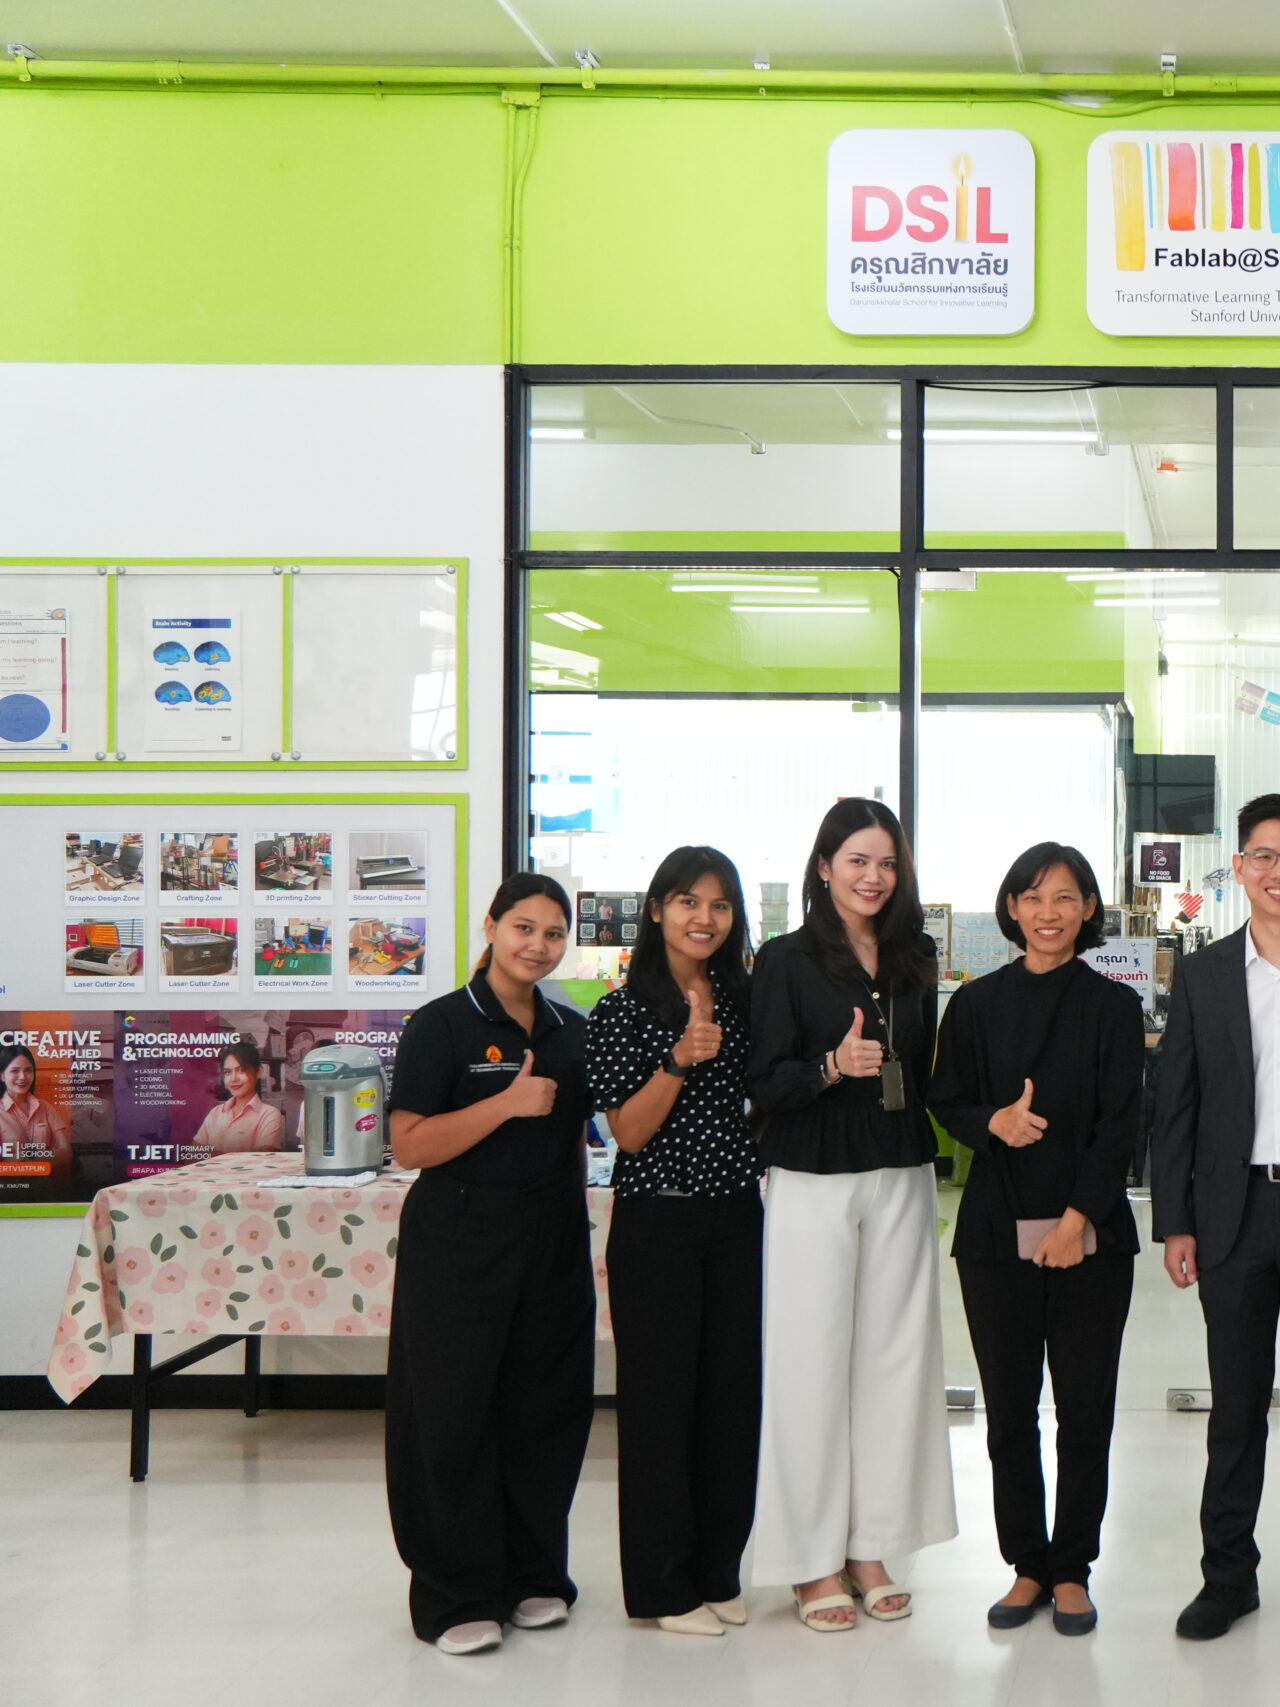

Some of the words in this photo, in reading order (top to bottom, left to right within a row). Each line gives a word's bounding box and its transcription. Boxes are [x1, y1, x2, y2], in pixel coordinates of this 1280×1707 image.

[851, 252, 1009, 283] ดรุณสิกขาลัย
[1115, 290, 1210, 304] Transformative
[1214, 290, 1271, 306] Learning
[1190, 309, 1245, 323] Stanford
[276, 894, 302, 902] printing
[378, 894, 402, 902] Cutting
[1096, 955, 1128, 966] กรุณา
[1, 1030, 101, 1047] CREATIVE
[124, 1032, 241, 1045] PROGRAMMING
[71, 1061, 101, 1071] ARTS
[21, 1142, 46, 1150] UPPER
[127, 1144, 174, 1160] T.JET
[20, 1150, 55, 1158] SCHOOL
